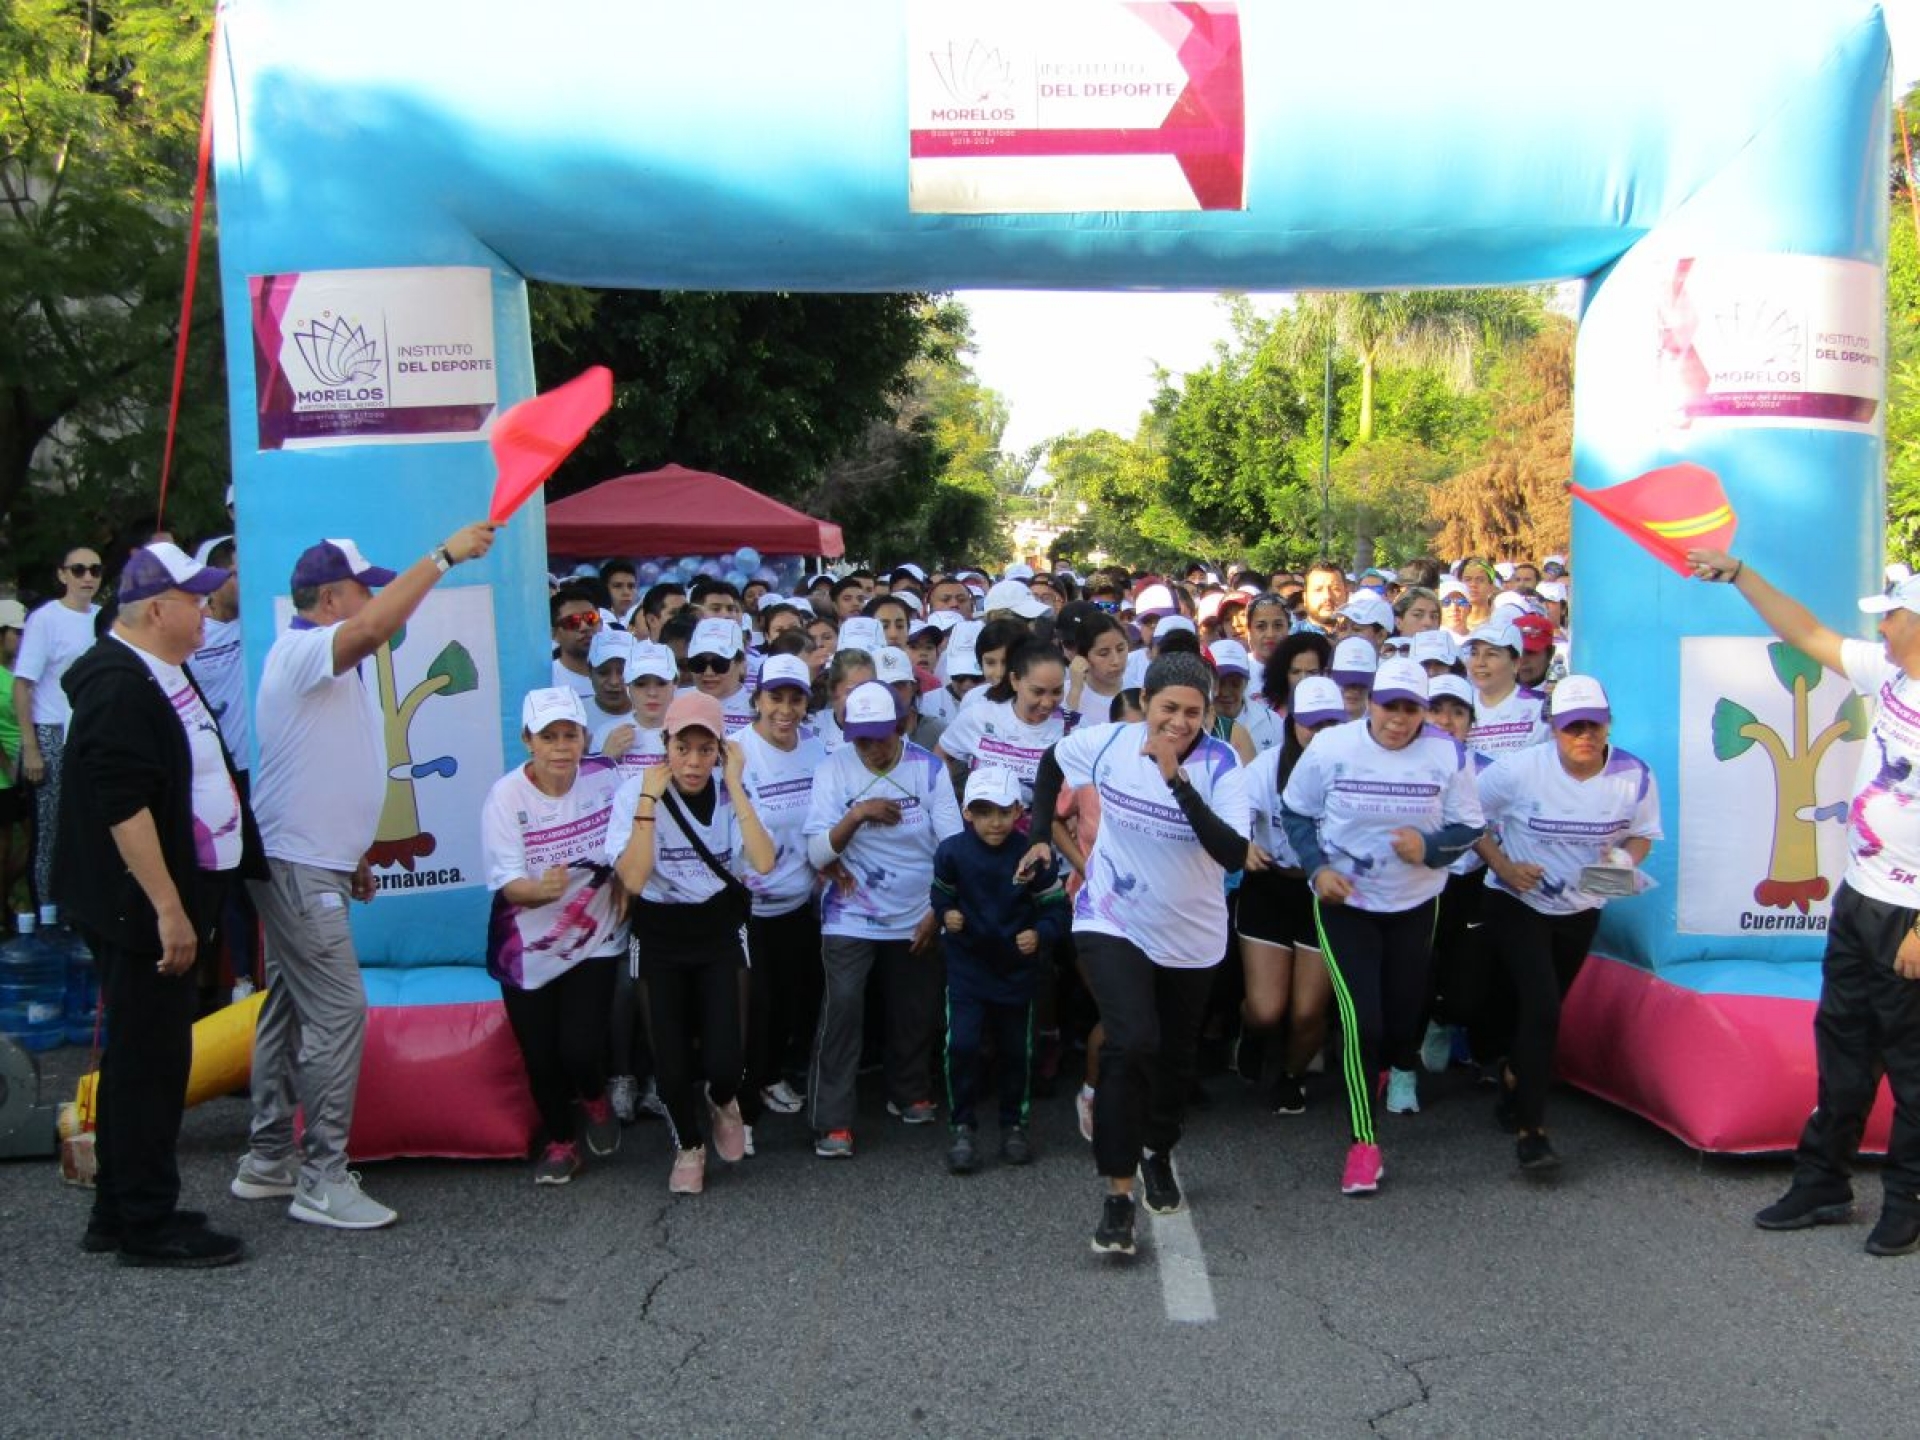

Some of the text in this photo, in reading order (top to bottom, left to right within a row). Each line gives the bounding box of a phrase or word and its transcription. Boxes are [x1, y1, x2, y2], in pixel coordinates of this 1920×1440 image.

[1040, 82, 1177, 97] DEL DEPORTE
[930, 108, 1016, 121] MORELOS
[1816, 332, 1870, 350] INSTITUTO
[397, 344, 473, 357] INSTITUTO
[1815, 348, 1838, 361] DEL
[397, 359, 493, 374] DEL DEPORTE
[1714, 370, 1801, 383] MORELOS
[298, 388, 384, 403] MORELOS
[372, 866, 466, 890] ernavaca.
[1740, 911, 1829, 931] Cuernava
